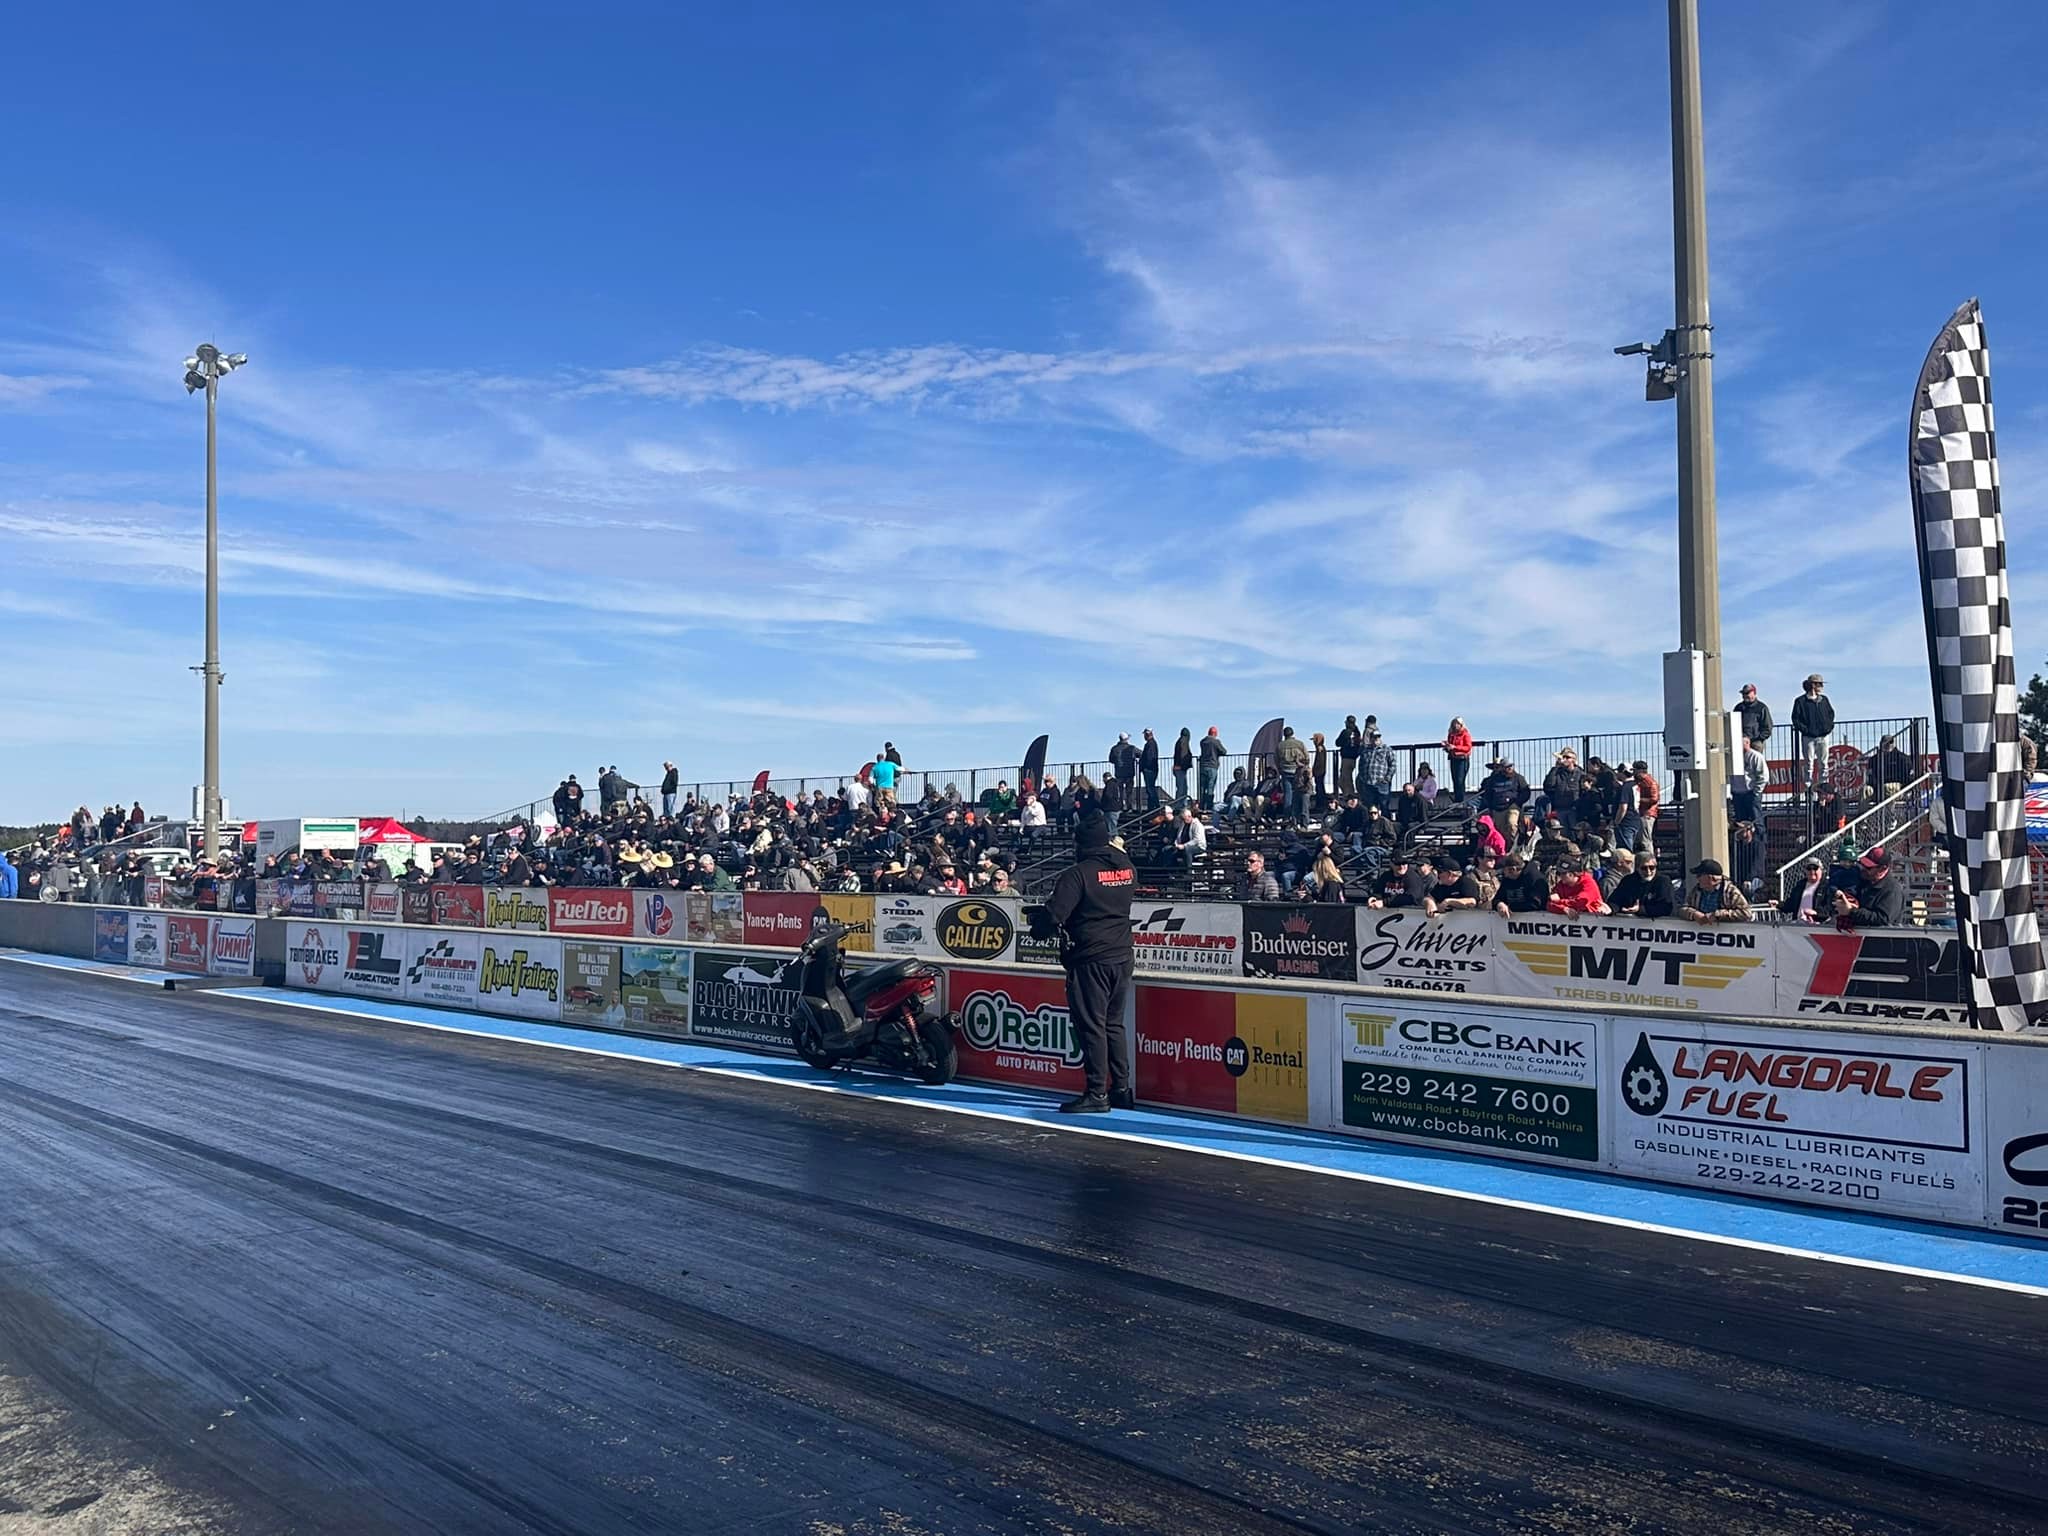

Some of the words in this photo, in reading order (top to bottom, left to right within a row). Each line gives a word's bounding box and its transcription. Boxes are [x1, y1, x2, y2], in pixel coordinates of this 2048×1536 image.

[746, 912, 776, 931] Yancey
[777, 913, 802, 930] Rents
[945, 925, 1004, 949] CALLIES
[1131, 932, 1167, 946] RANK
[1250, 931, 1348, 956] Budweiser
[1360, 913, 1487, 970] Shiver
[1507, 922, 1600, 939] MICKEY
[1602, 926, 1756, 948] THOMPSON
[1152, 949, 1188, 962] RACING
[1194, 951, 1233, 965] SCHOOL
[1277, 959, 1319, 974] RACING
[1398, 957, 1487, 972] CARTS
[1569, 945, 1697, 986] M/T
[1383, 978, 1466, 993] 386-0678
[1553, 986, 1609, 1001] TIRES
[1624, 991, 1699, 1009] WHEELS
[695, 980, 801, 1017] BLACKHAWK
[700, 1007, 738, 1021] RACE
[748, 1012, 792, 1028] CARS
[963, 993, 1083, 1062] O'Reilly
[694, 1024, 794, 1045] www.blackhawkracecars.co
[1399, 1019, 1493, 1049] CBC
[1496, 1033, 1586, 1058] BANK
[1136, 1032, 1181, 1063] Yancey
[1184, 1037, 1223, 1062] Rents
[1226, 1048, 1245, 1066] CAT
[1252, 1046, 1303, 1068] Rental
[1353, 1046, 1399, 1058] Committed
[1399, 1044, 1470, 1057] COMMERCIAL
[1473, 1051, 1524, 1062] BANKING
[1528, 1056, 1587, 1068] COMPANY
[996, 1055, 1022, 1069] AUTO
[1024, 1059, 1057, 1074] PARTS
[1672, 1046, 1954, 1102] LANGDALE
[1361, 1072, 1411, 1095] 229
[1423, 1079, 1477, 1104] 242
[1491, 1086, 1570, 1116] 7600
[1680, 1086, 1789, 1123] FUEL
[1353, 1094, 1379, 1105] North
[1381, 1098, 1423, 1111] Valdosta
[1425, 1103, 1452, 1115] Road
[1507, 1113, 1536, 1126] Road
[1546, 1119, 1584, 1133] Hahira
[1371, 1111, 1559, 1149] www.cbcbank.com
[1657, 1122, 1778, 1148] INDUSTRIAL
[1785, 1137, 1925, 1165] LUBRICANTS
[1697, 1163, 1880, 1200] 229-242-2200
[1810, 1162, 1882, 1181] RACING
[1890, 1172, 1955, 1190] FUELS
